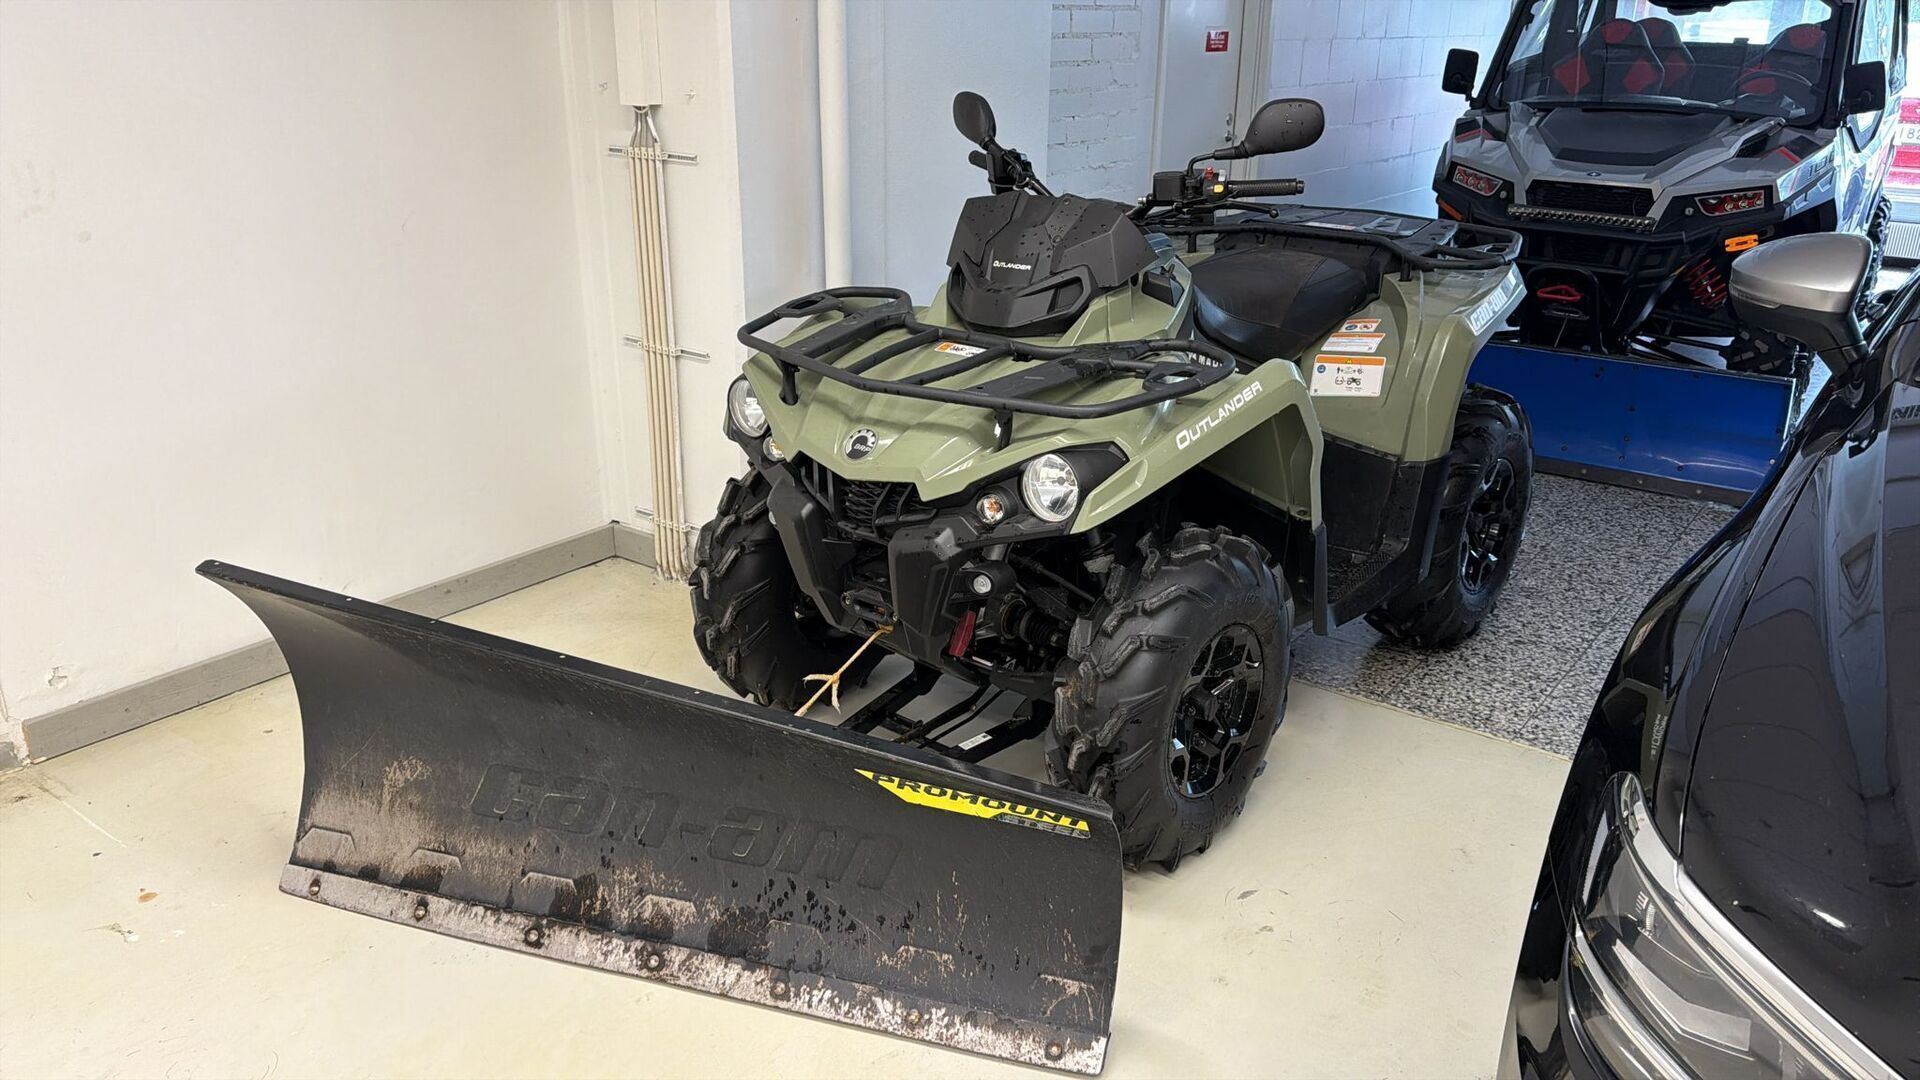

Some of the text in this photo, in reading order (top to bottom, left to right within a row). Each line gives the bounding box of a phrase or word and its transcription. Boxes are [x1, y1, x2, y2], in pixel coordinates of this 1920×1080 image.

[992, 260, 1032, 271] OUTLANDER
[1175, 380, 1263, 451] OUTLANDER
[853, 443, 872, 452] BRP
[871, 771, 1085, 828] PROMOUNT
